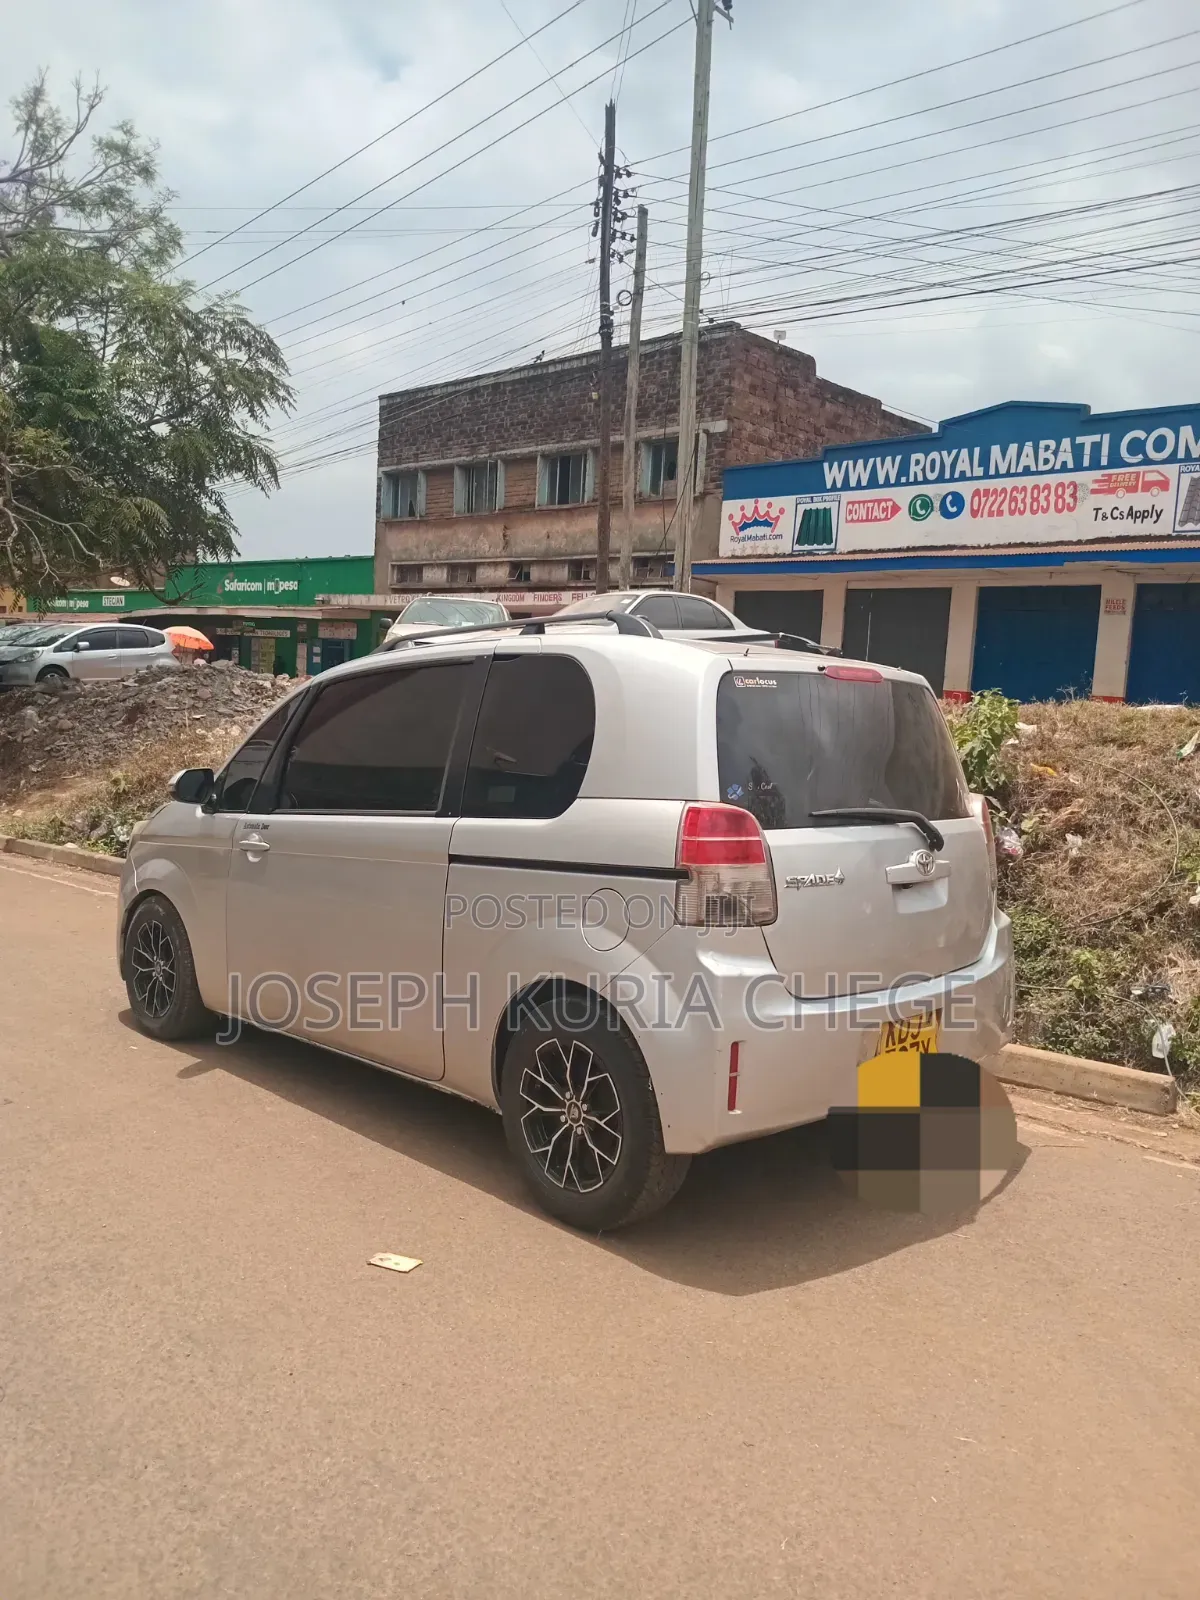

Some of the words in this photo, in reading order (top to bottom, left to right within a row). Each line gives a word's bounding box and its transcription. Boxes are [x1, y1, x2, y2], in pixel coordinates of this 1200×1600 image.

[1111, 473, 1137, 482] FREE
[846, 501, 893, 521] CONTACT
[1126, 504, 1164, 524] Apply
[224, 578, 262, 592] Safaricom
[496, 592, 525, 602] KINGDOM
[533, 592, 562, 602] FINDERS
[745, 676, 777, 685] carlocus
[784, 873, 836, 891] SPADE
